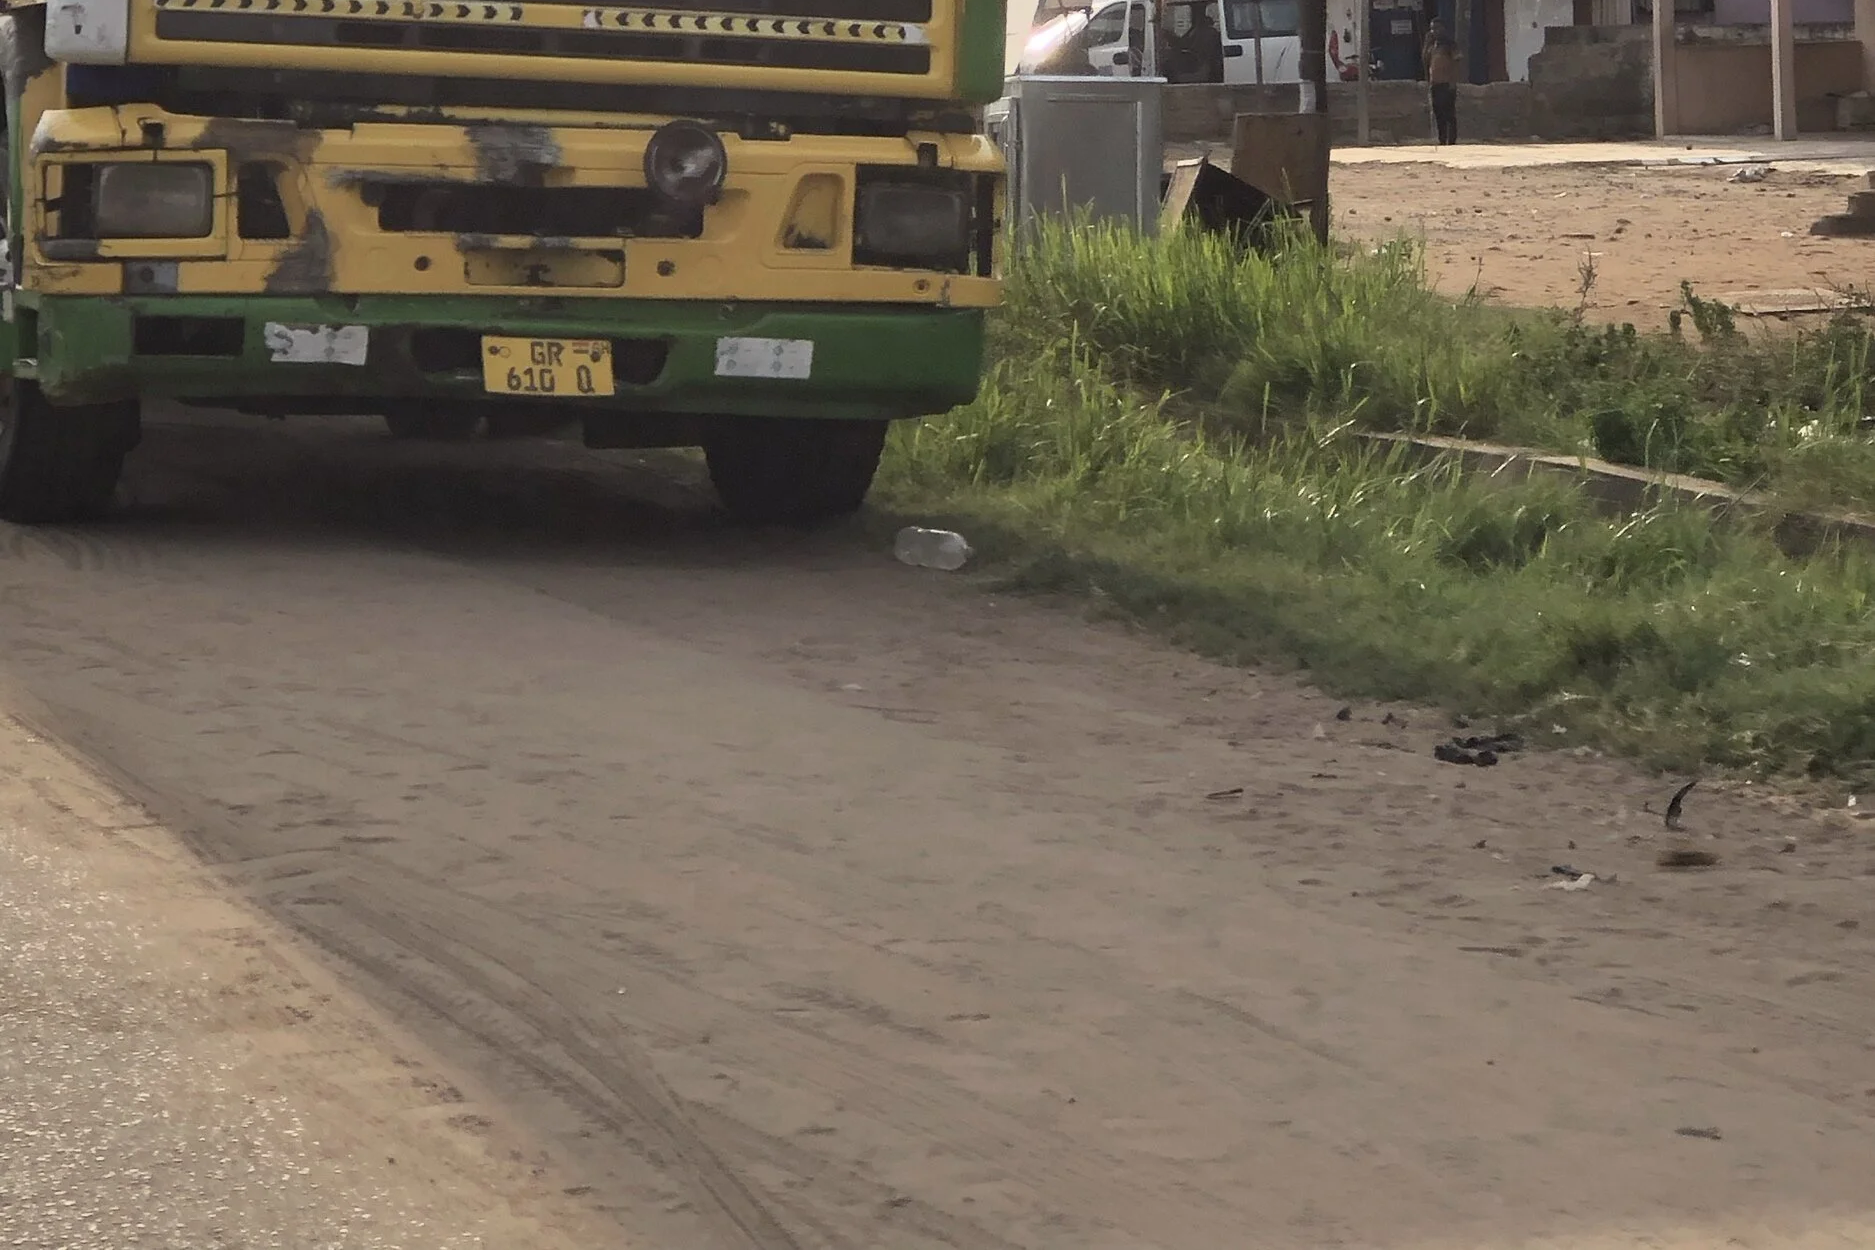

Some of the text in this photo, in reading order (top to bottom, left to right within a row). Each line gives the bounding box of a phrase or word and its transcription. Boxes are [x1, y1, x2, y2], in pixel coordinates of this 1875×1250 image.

[530, 341, 565, 367] GR
[507, 364, 595, 393] 610 Q
